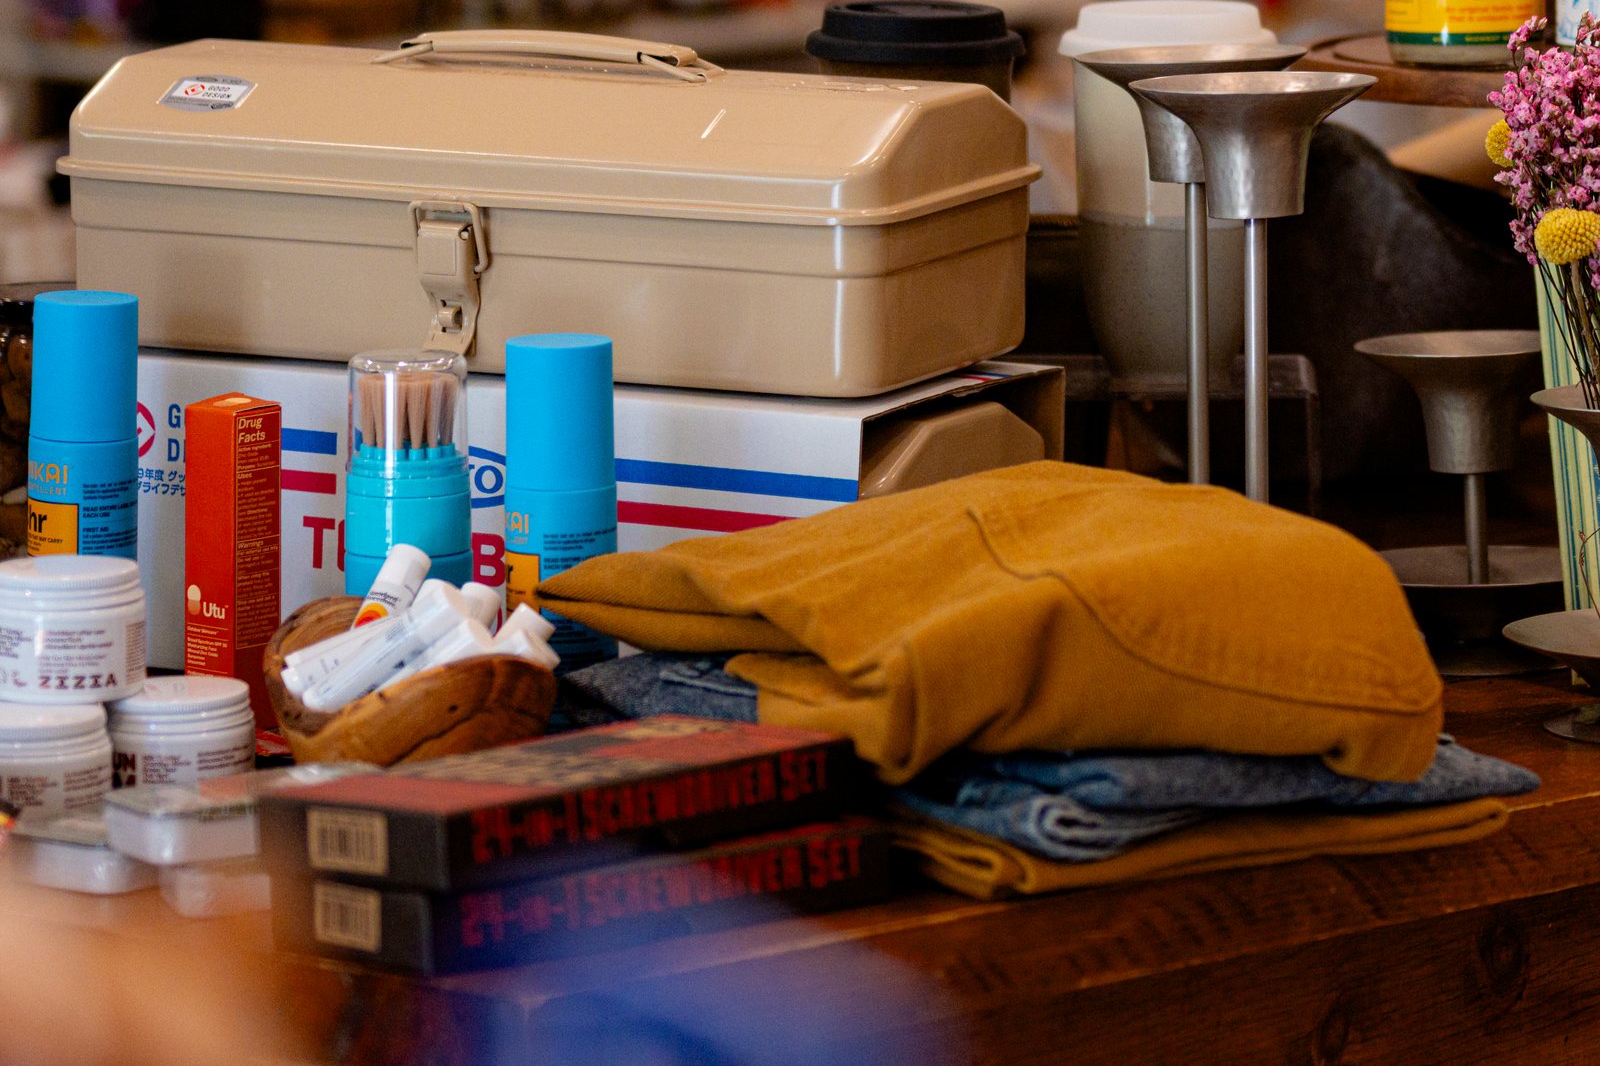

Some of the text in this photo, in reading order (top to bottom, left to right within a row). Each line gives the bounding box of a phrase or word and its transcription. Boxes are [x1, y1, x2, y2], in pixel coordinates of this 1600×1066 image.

[238, 417, 263, 430] Drug
[238, 431, 266, 444] Facts
[203, 601, 226, 620] Utu
[38, 672, 118, 690] ZIZIA
[780, 748, 829, 802] SET
